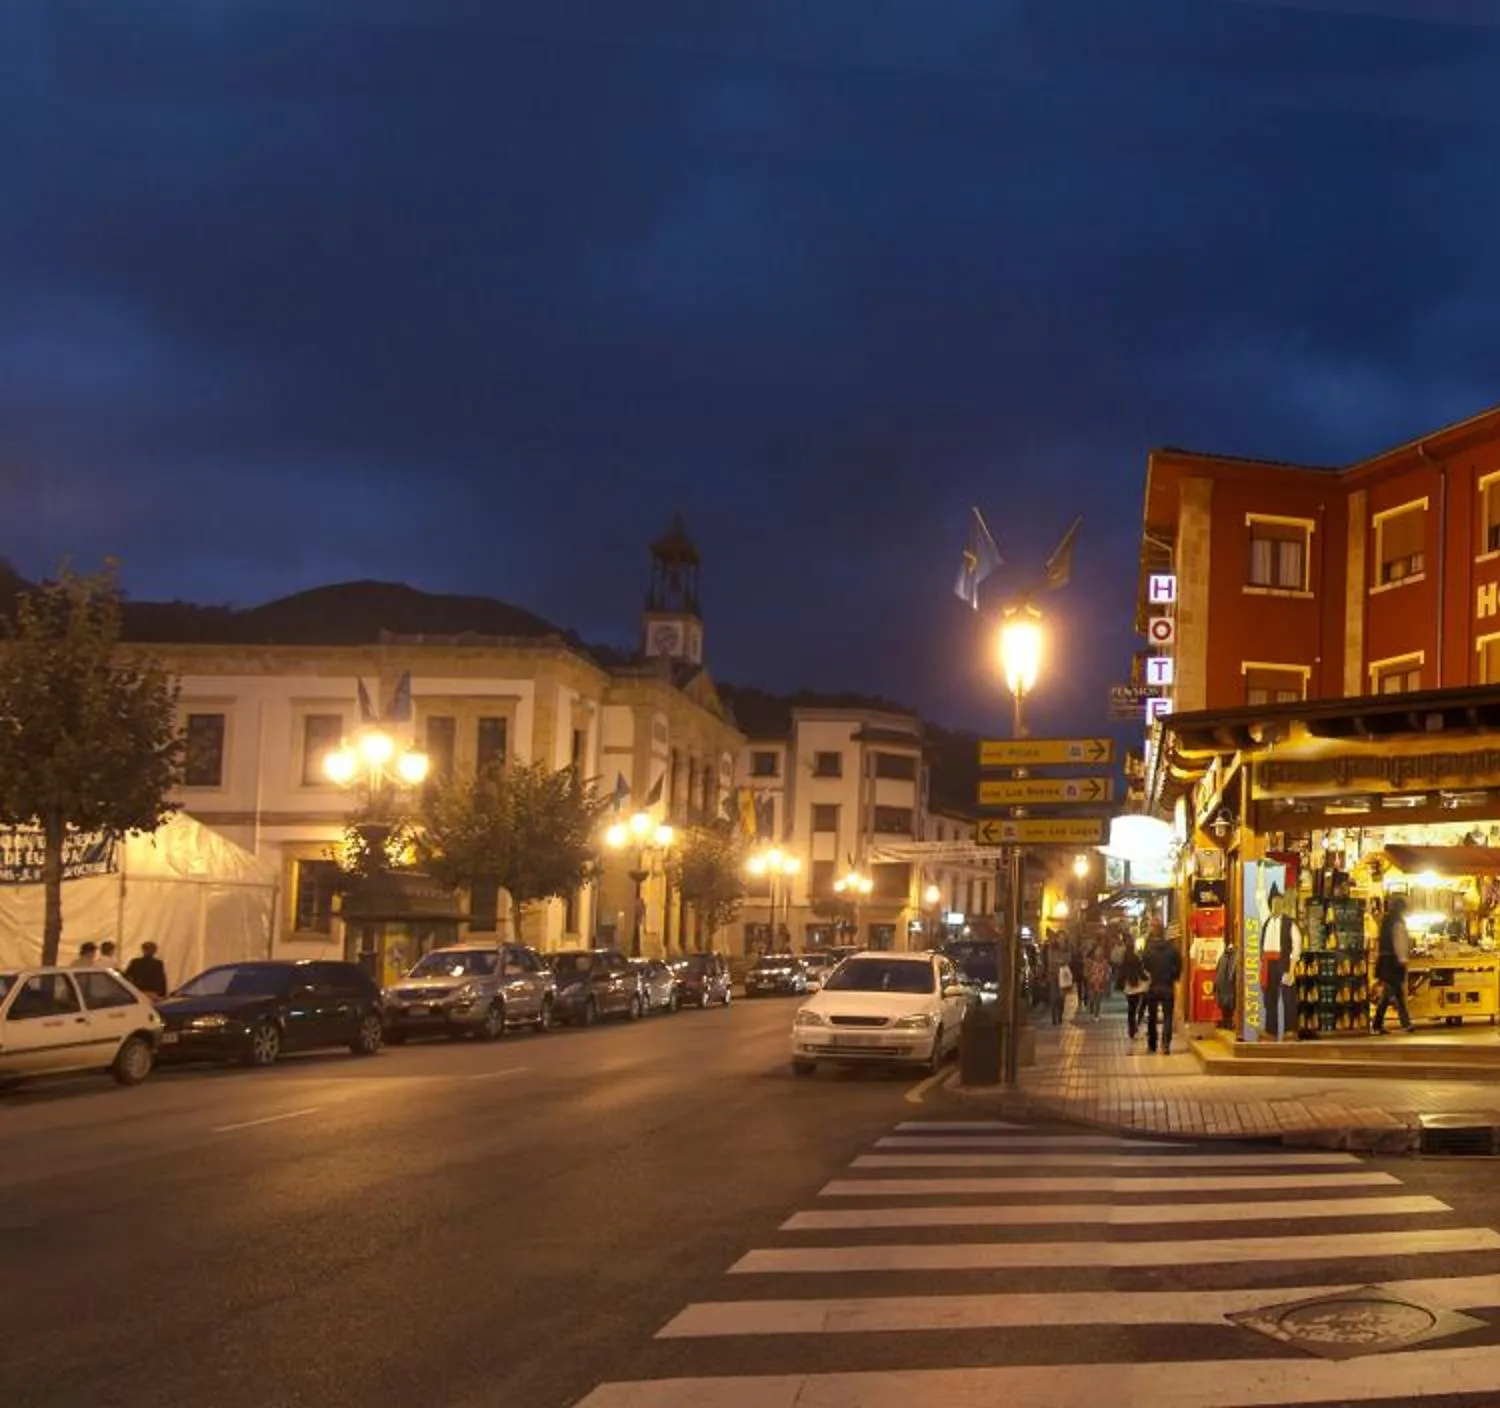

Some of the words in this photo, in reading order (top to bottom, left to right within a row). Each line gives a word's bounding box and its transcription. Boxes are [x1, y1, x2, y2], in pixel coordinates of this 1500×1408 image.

[1152, 578, 1173, 718] HOTE
[25, 848, 83, 866] EUPA
[1245, 918, 1259, 1027] ASTURIAS
